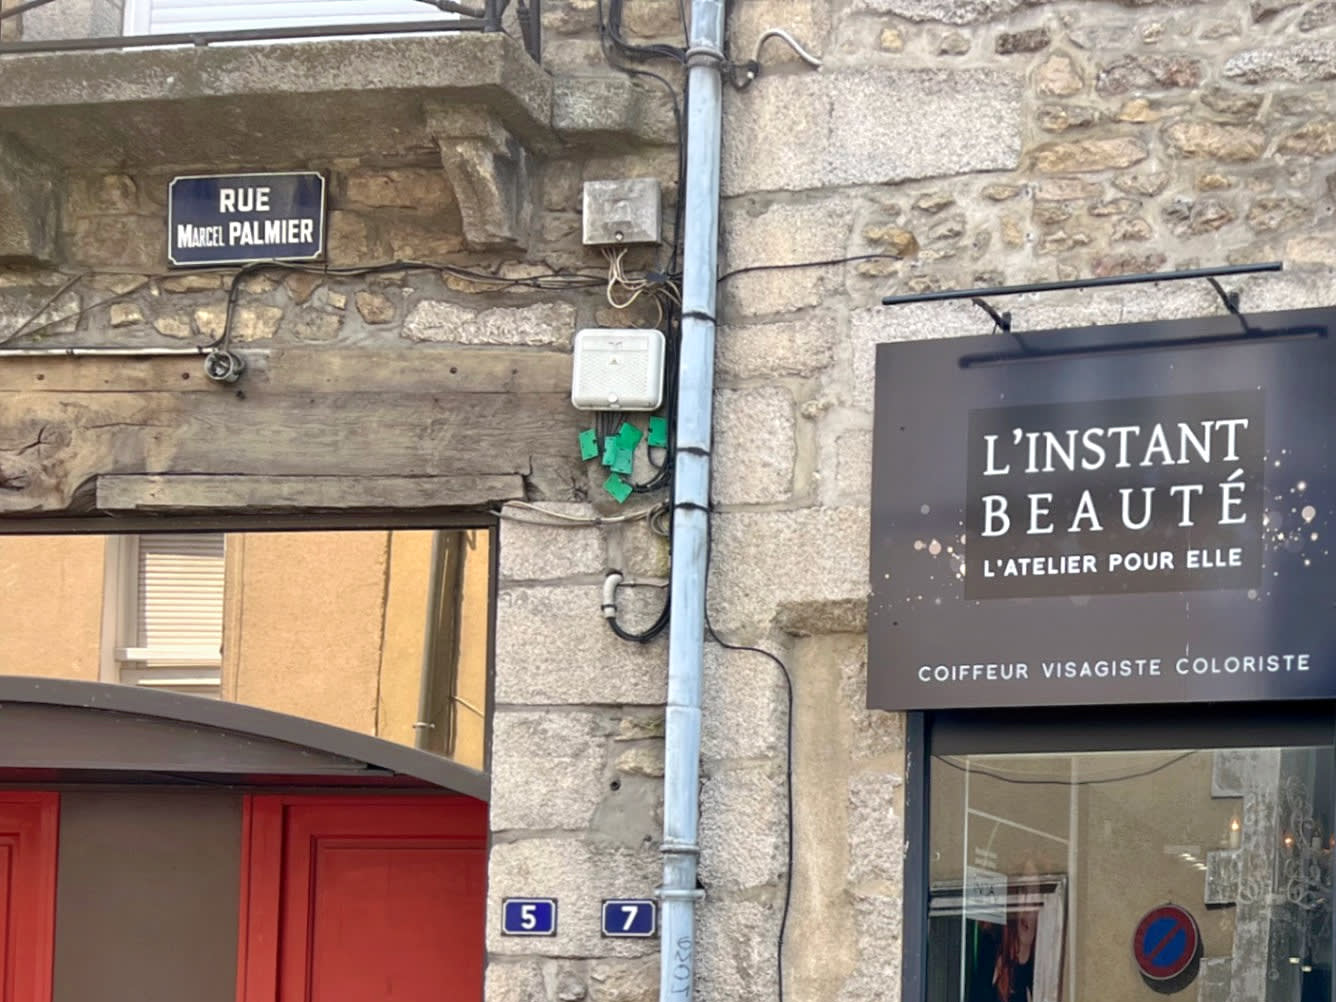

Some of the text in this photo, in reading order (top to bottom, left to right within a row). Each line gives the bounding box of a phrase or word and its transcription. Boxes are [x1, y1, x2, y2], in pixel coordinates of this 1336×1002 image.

[219, 187, 271, 213] RUE
[229, 218, 314, 246] PALMIER
[983, 418, 1249, 476] L'INSTANT
[981, 468, 1247, 537] BEAUTÉ
[984, 548, 1242, 578] L'ATELIER POUR ELLE
[917, 654, 1311, 682] COIFFEUR VISAGISTE COLORISTE
[520, 904, 537, 930] 5
[620, 905, 639, 931] 7
